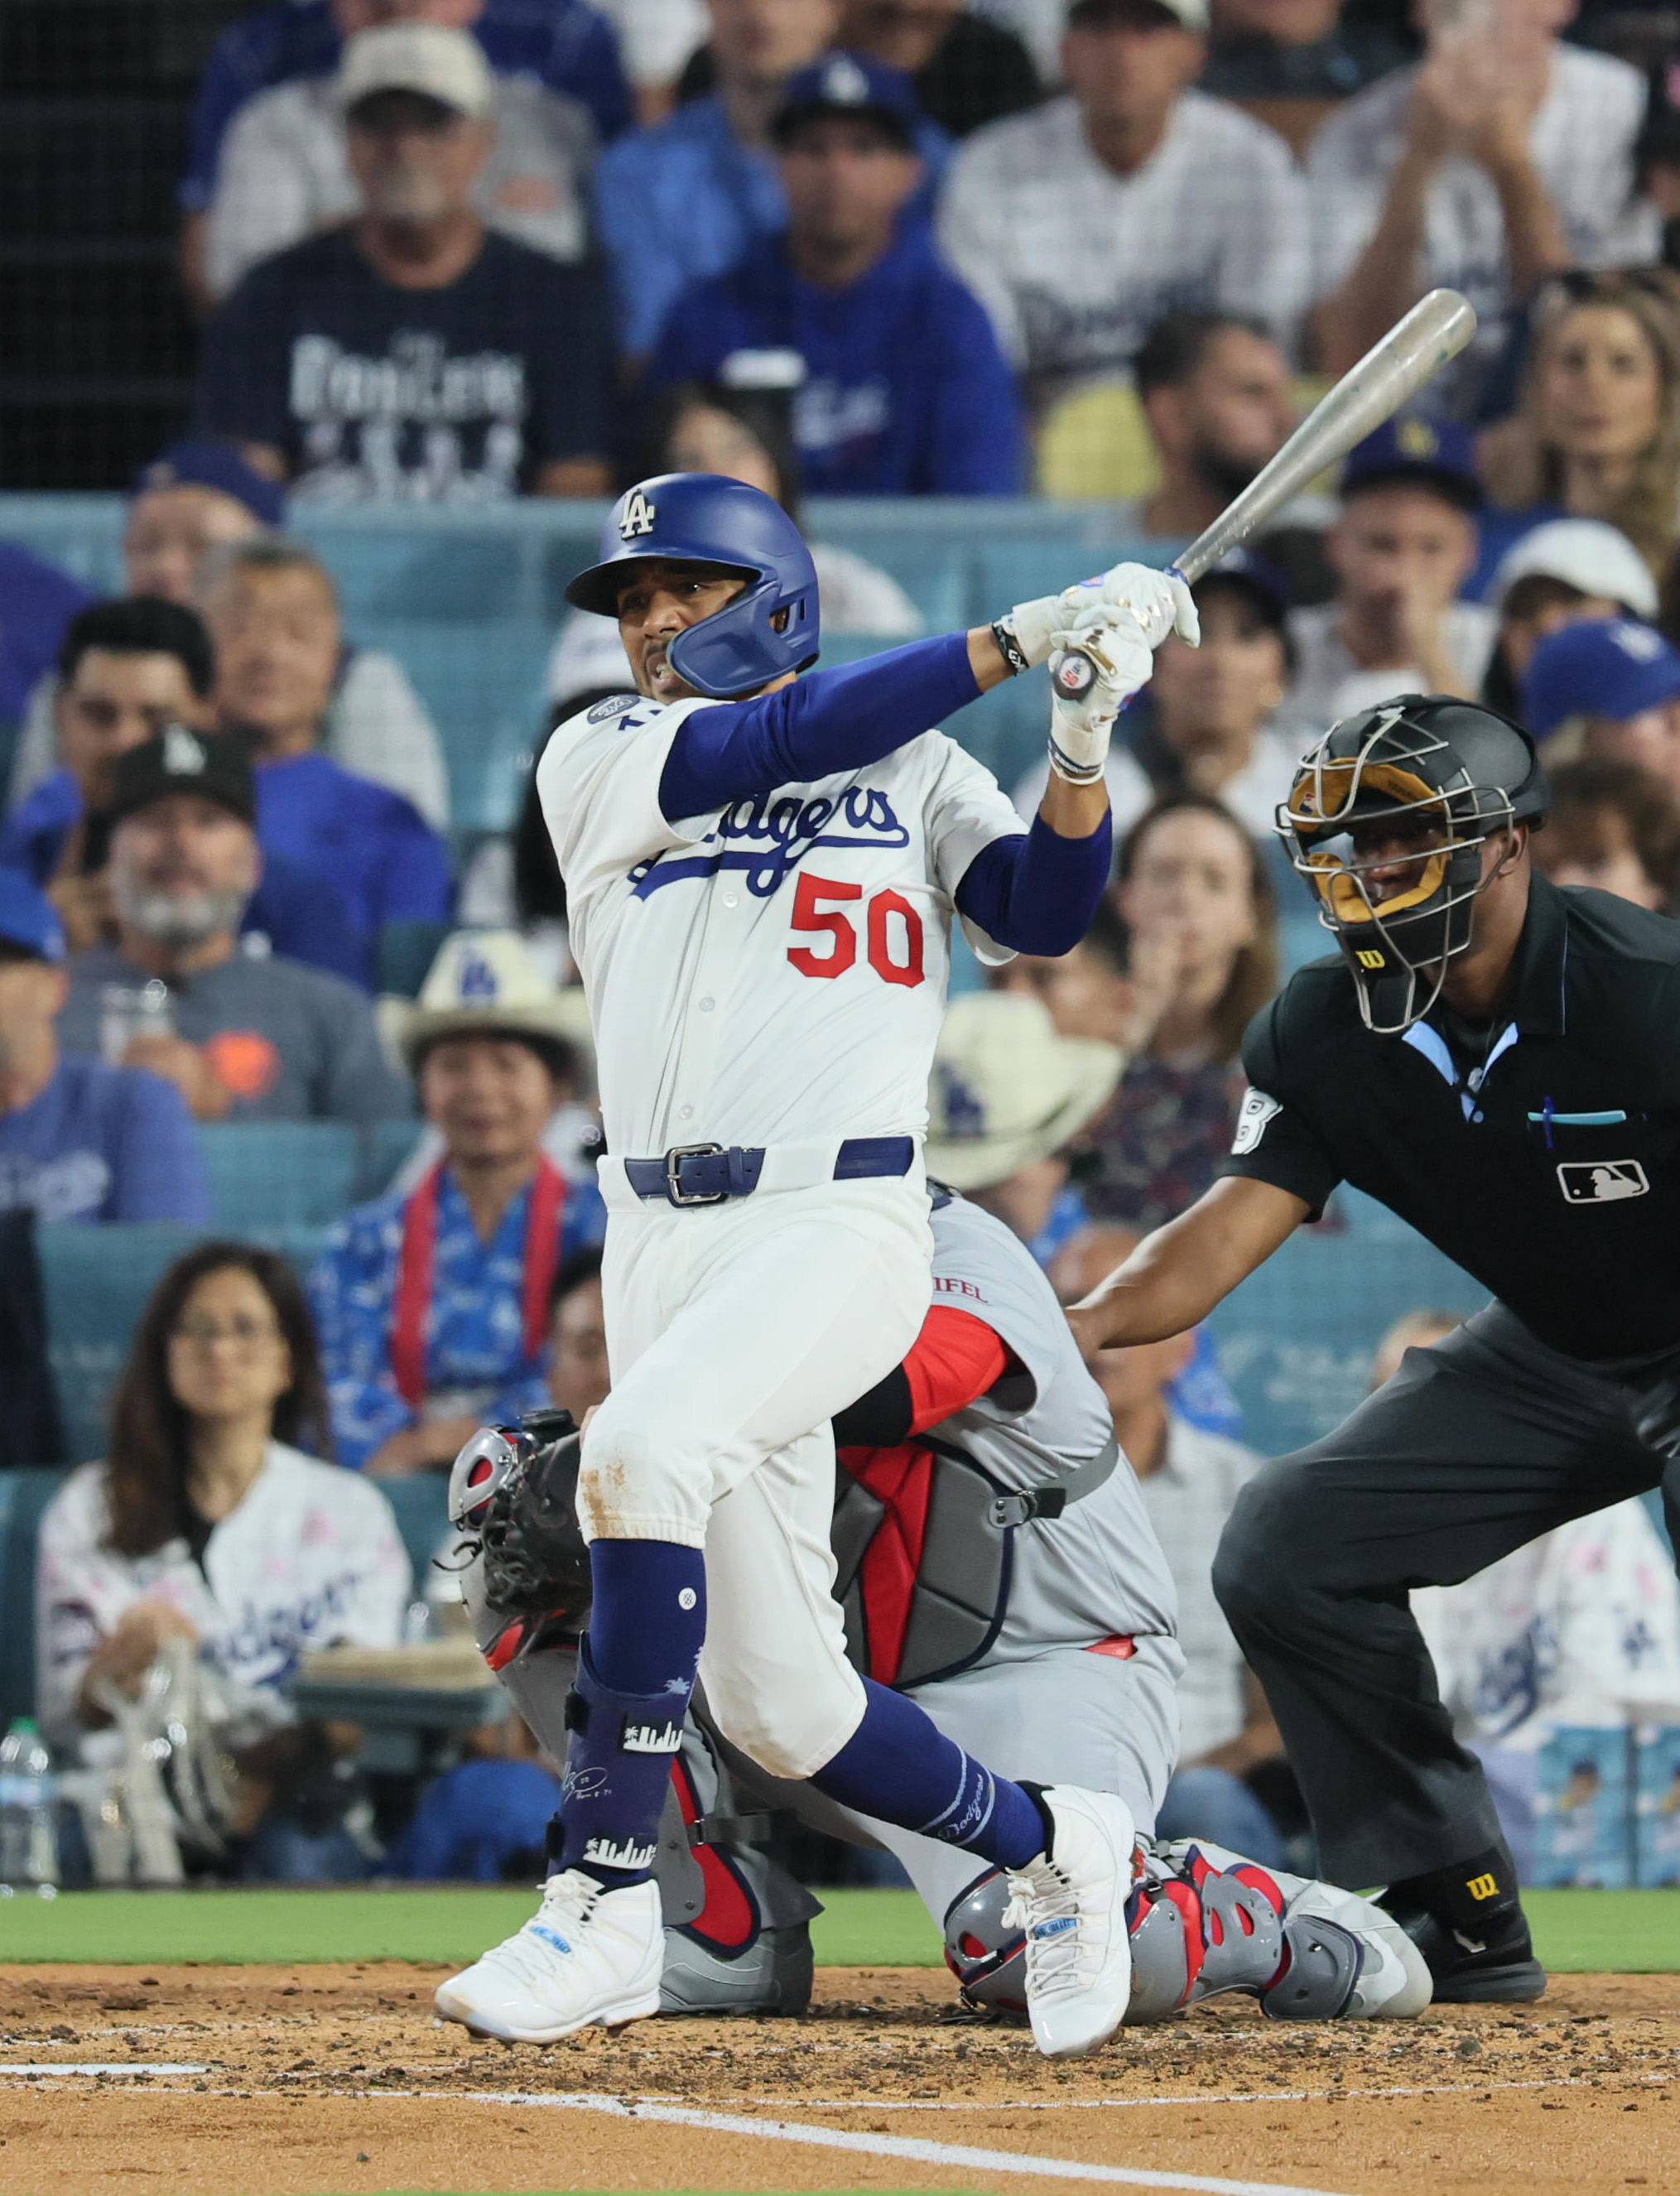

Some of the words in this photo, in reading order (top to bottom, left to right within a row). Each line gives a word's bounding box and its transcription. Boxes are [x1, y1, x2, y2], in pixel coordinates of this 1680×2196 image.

[619, 489, 656, 540] LA
[627, 785, 910, 902] dgers
[787, 871, 926, 989] 50
